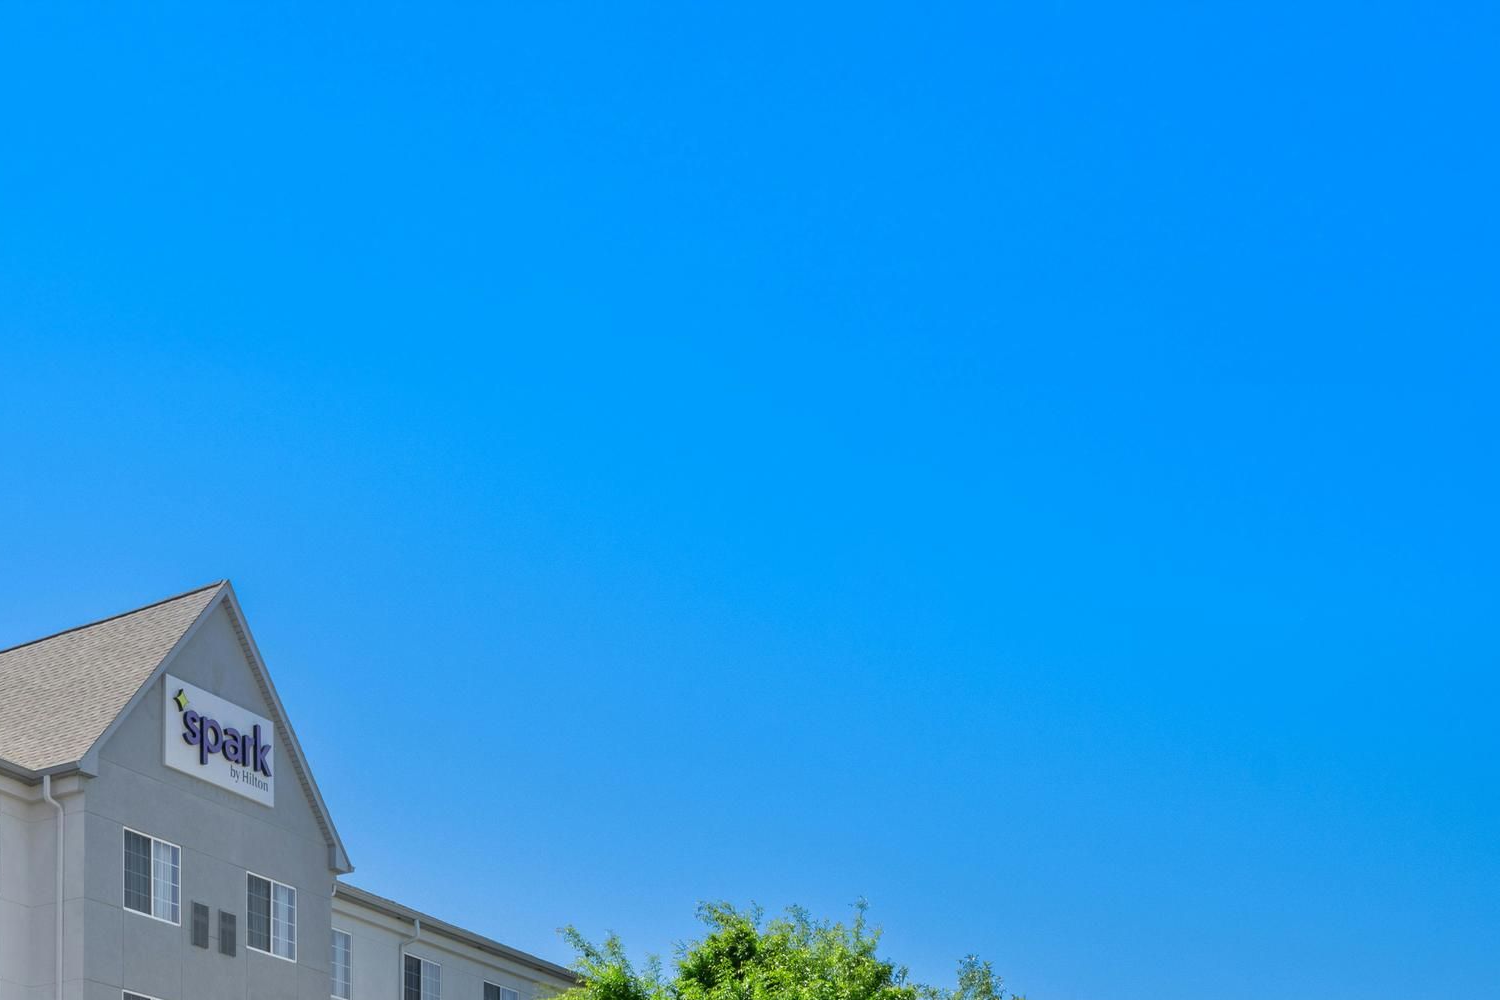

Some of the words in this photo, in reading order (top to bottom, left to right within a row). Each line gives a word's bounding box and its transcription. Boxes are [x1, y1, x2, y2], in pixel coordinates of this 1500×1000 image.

[182, 710, 272, 777] spark
[230, 764, 241, 782] by
[242, 770, 269, 792] Hilton
